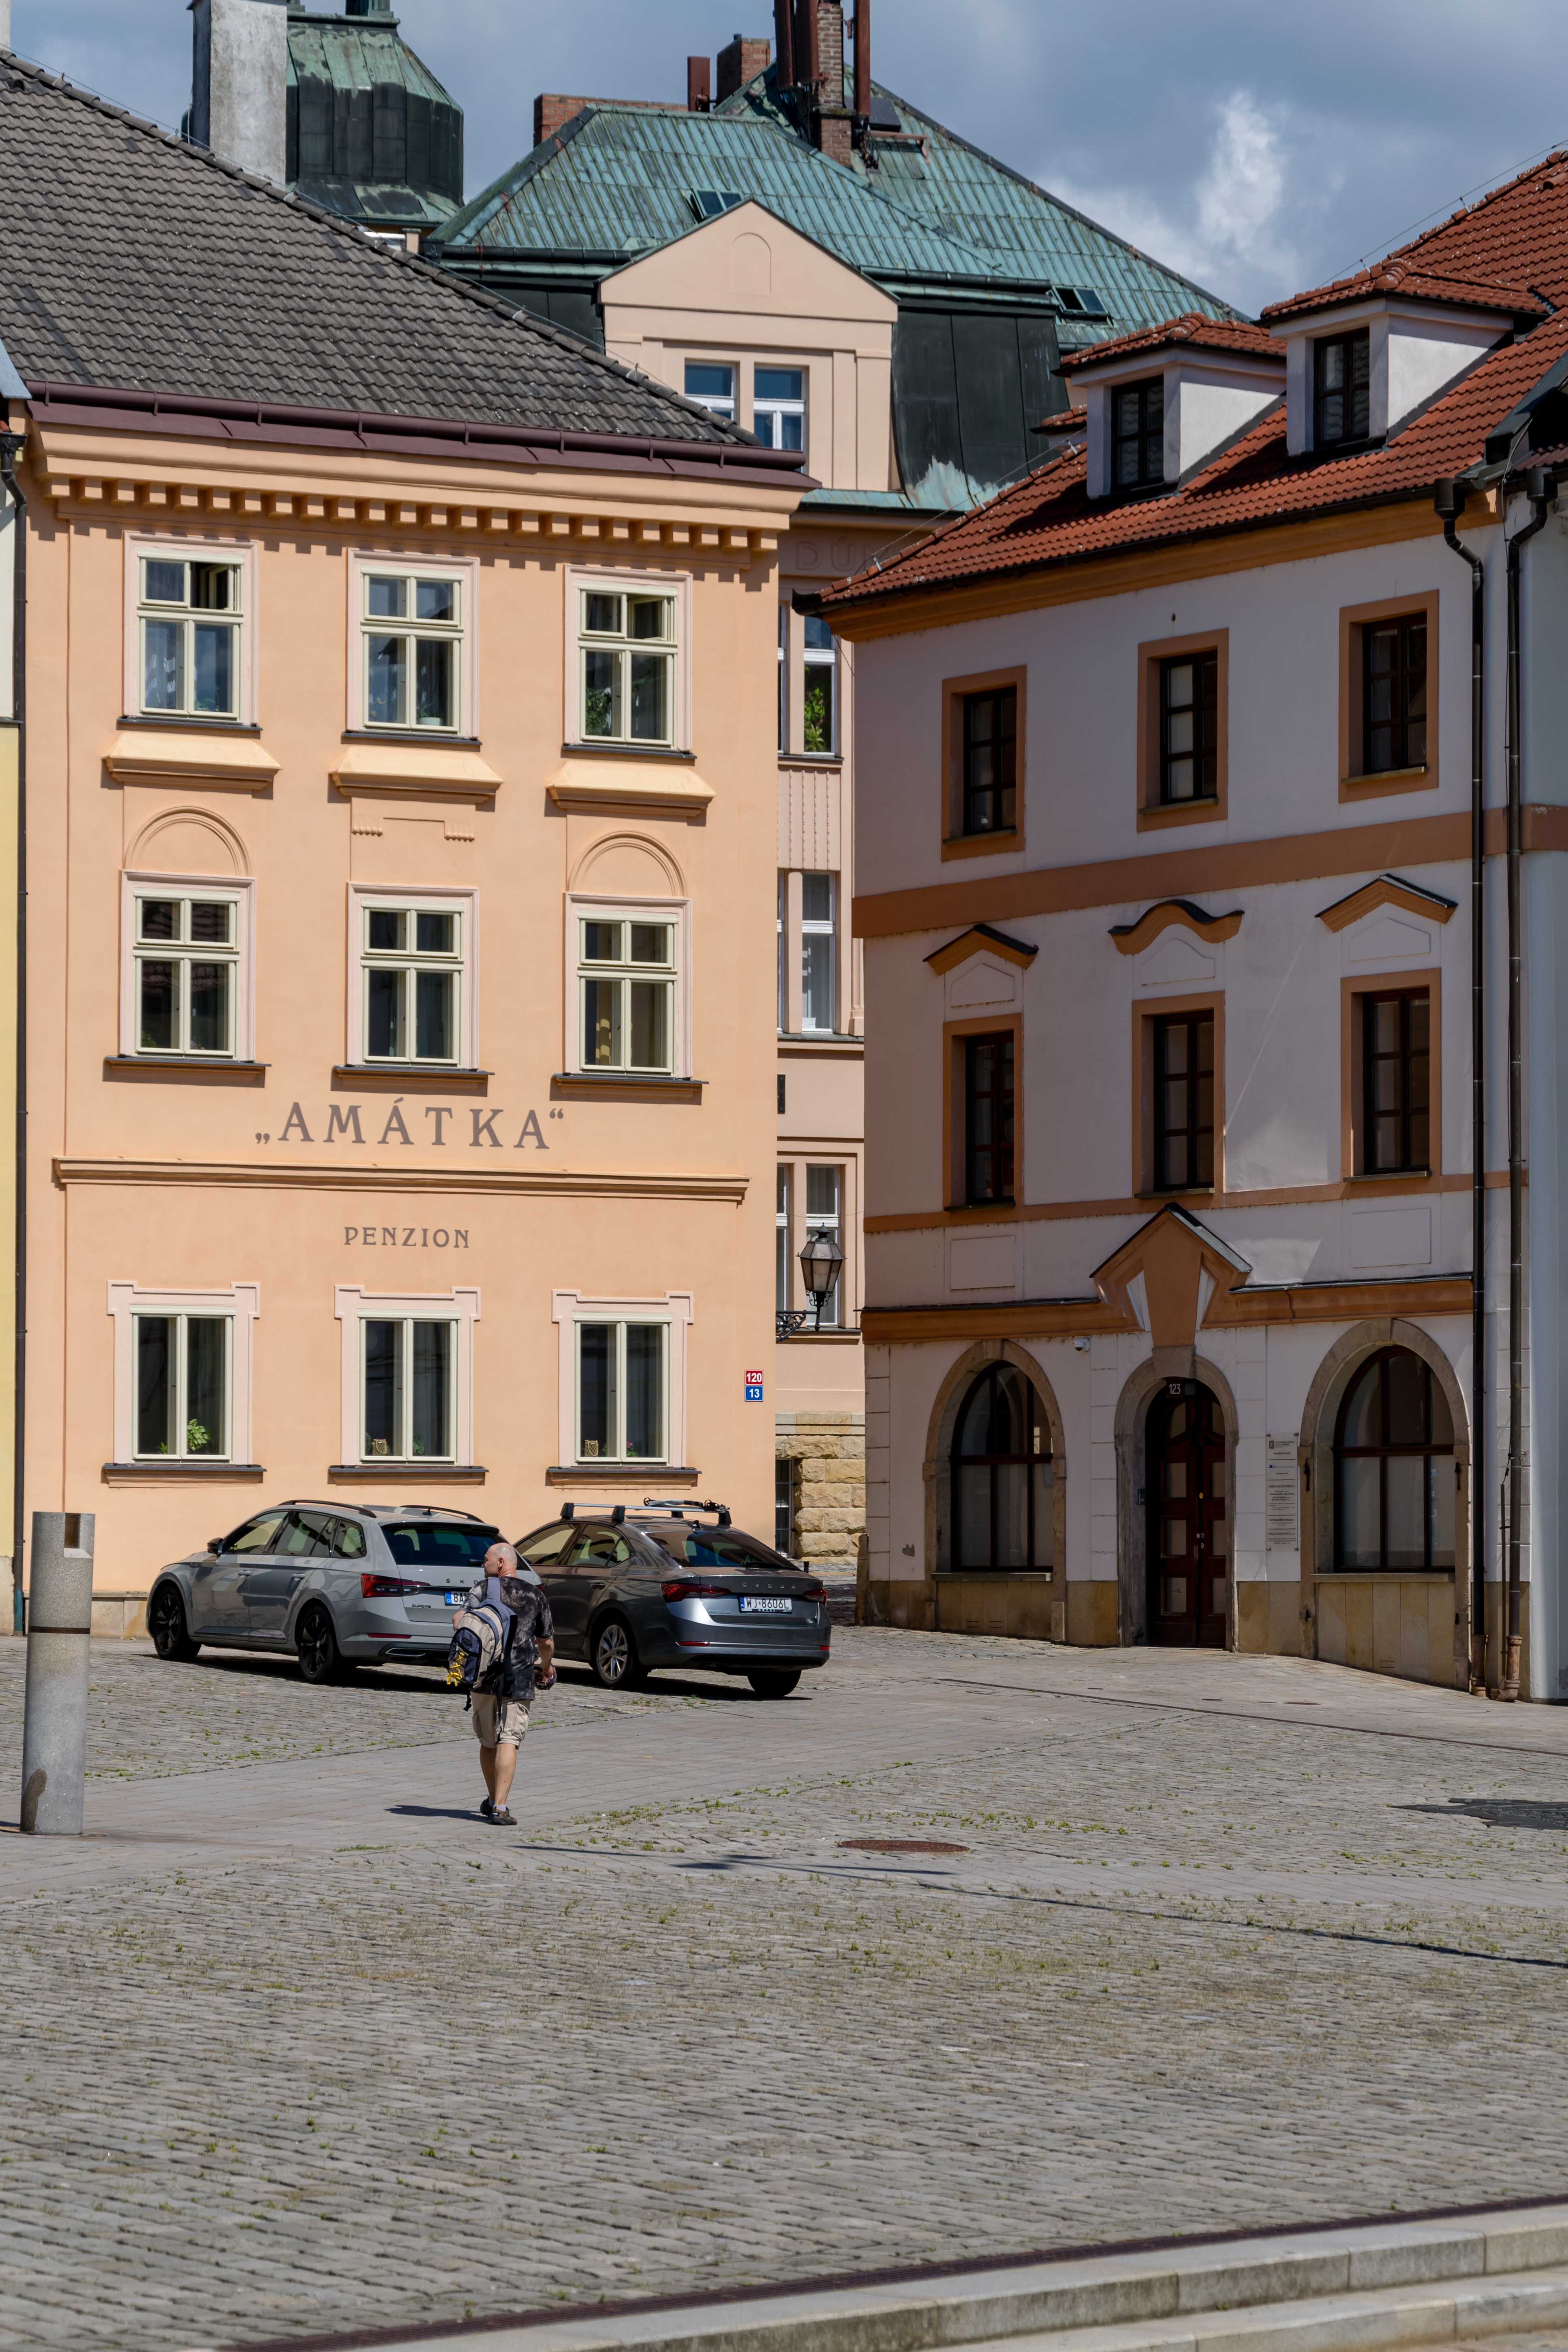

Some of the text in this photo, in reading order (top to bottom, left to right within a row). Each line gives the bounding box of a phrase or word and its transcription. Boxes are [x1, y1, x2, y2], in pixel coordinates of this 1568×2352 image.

[344, 1226, 469, 1248] PENZION
[746, 1373, 762, 1382] 120
[749, 1388, 760, 1398] 13
[1169, 1383, 1181, 1394] 123
